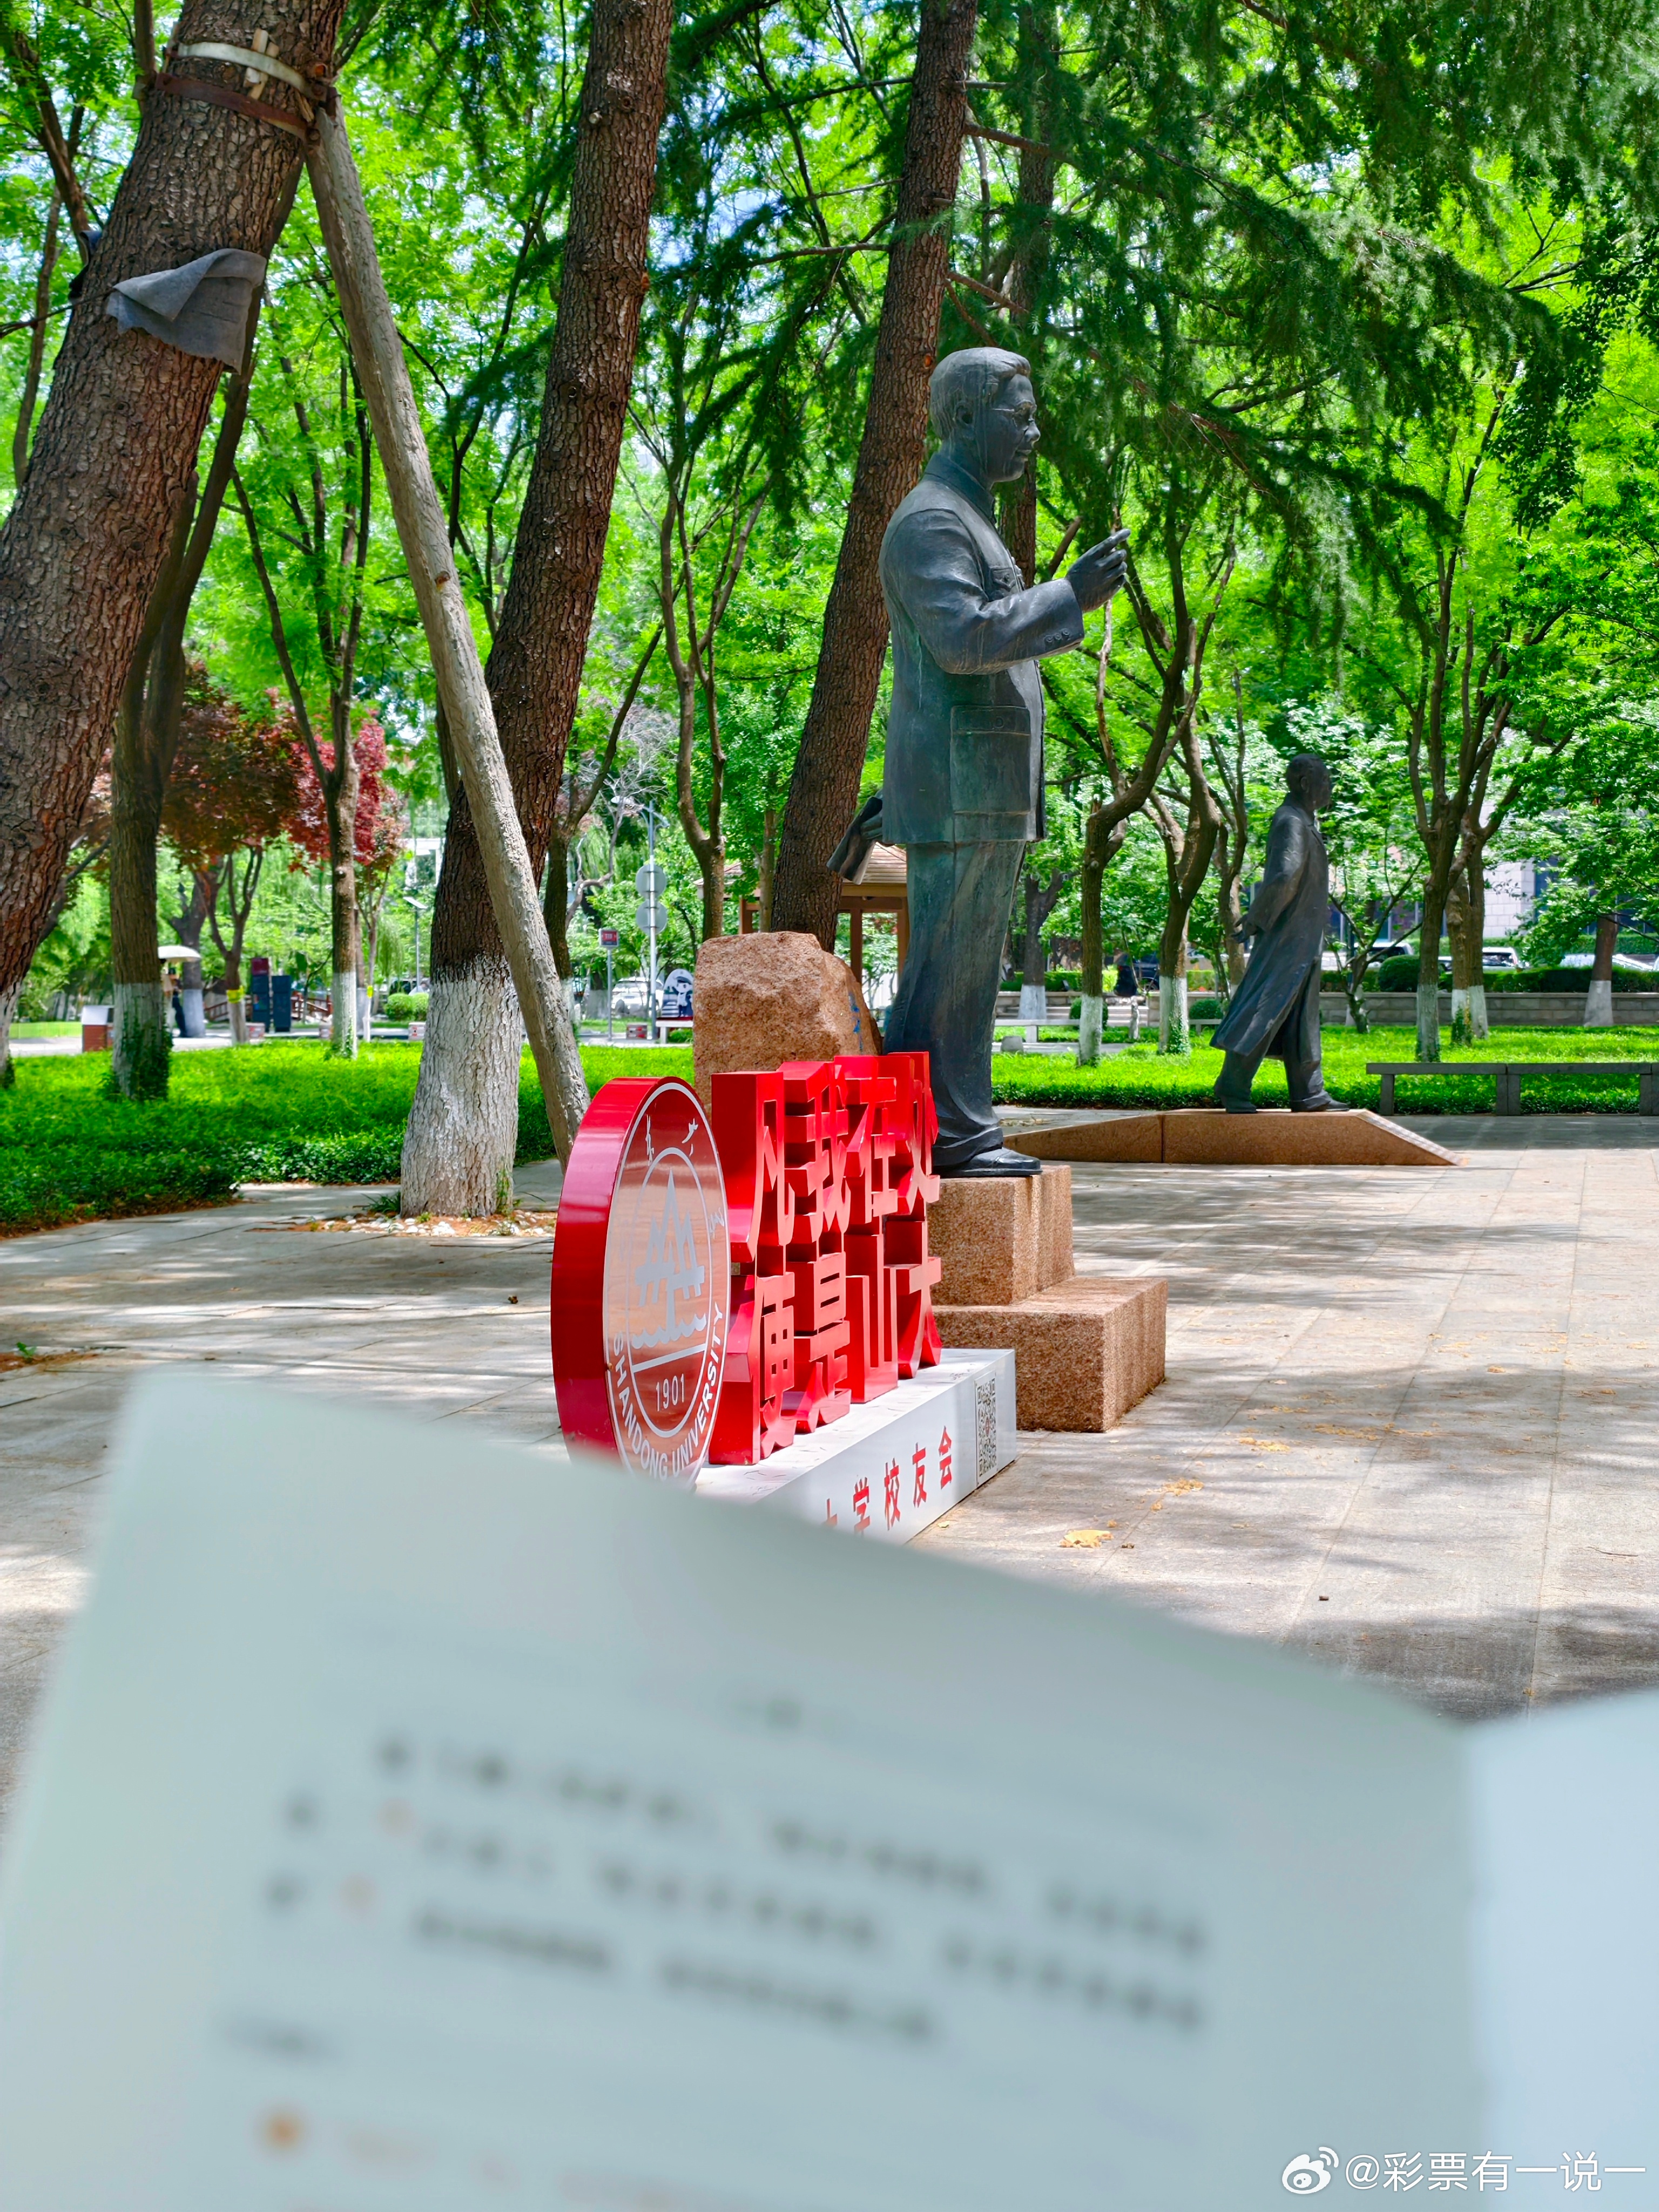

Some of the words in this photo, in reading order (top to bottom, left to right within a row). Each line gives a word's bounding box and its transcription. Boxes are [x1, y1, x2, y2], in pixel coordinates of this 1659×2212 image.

[613, 1330, 669, 1482] SHANDONG
[672, 1301, 723, 1478] UNIVERSITY
[656, 1373, 685, 1412] 1901
[747, 1219, 943, 1465] 便是山大
